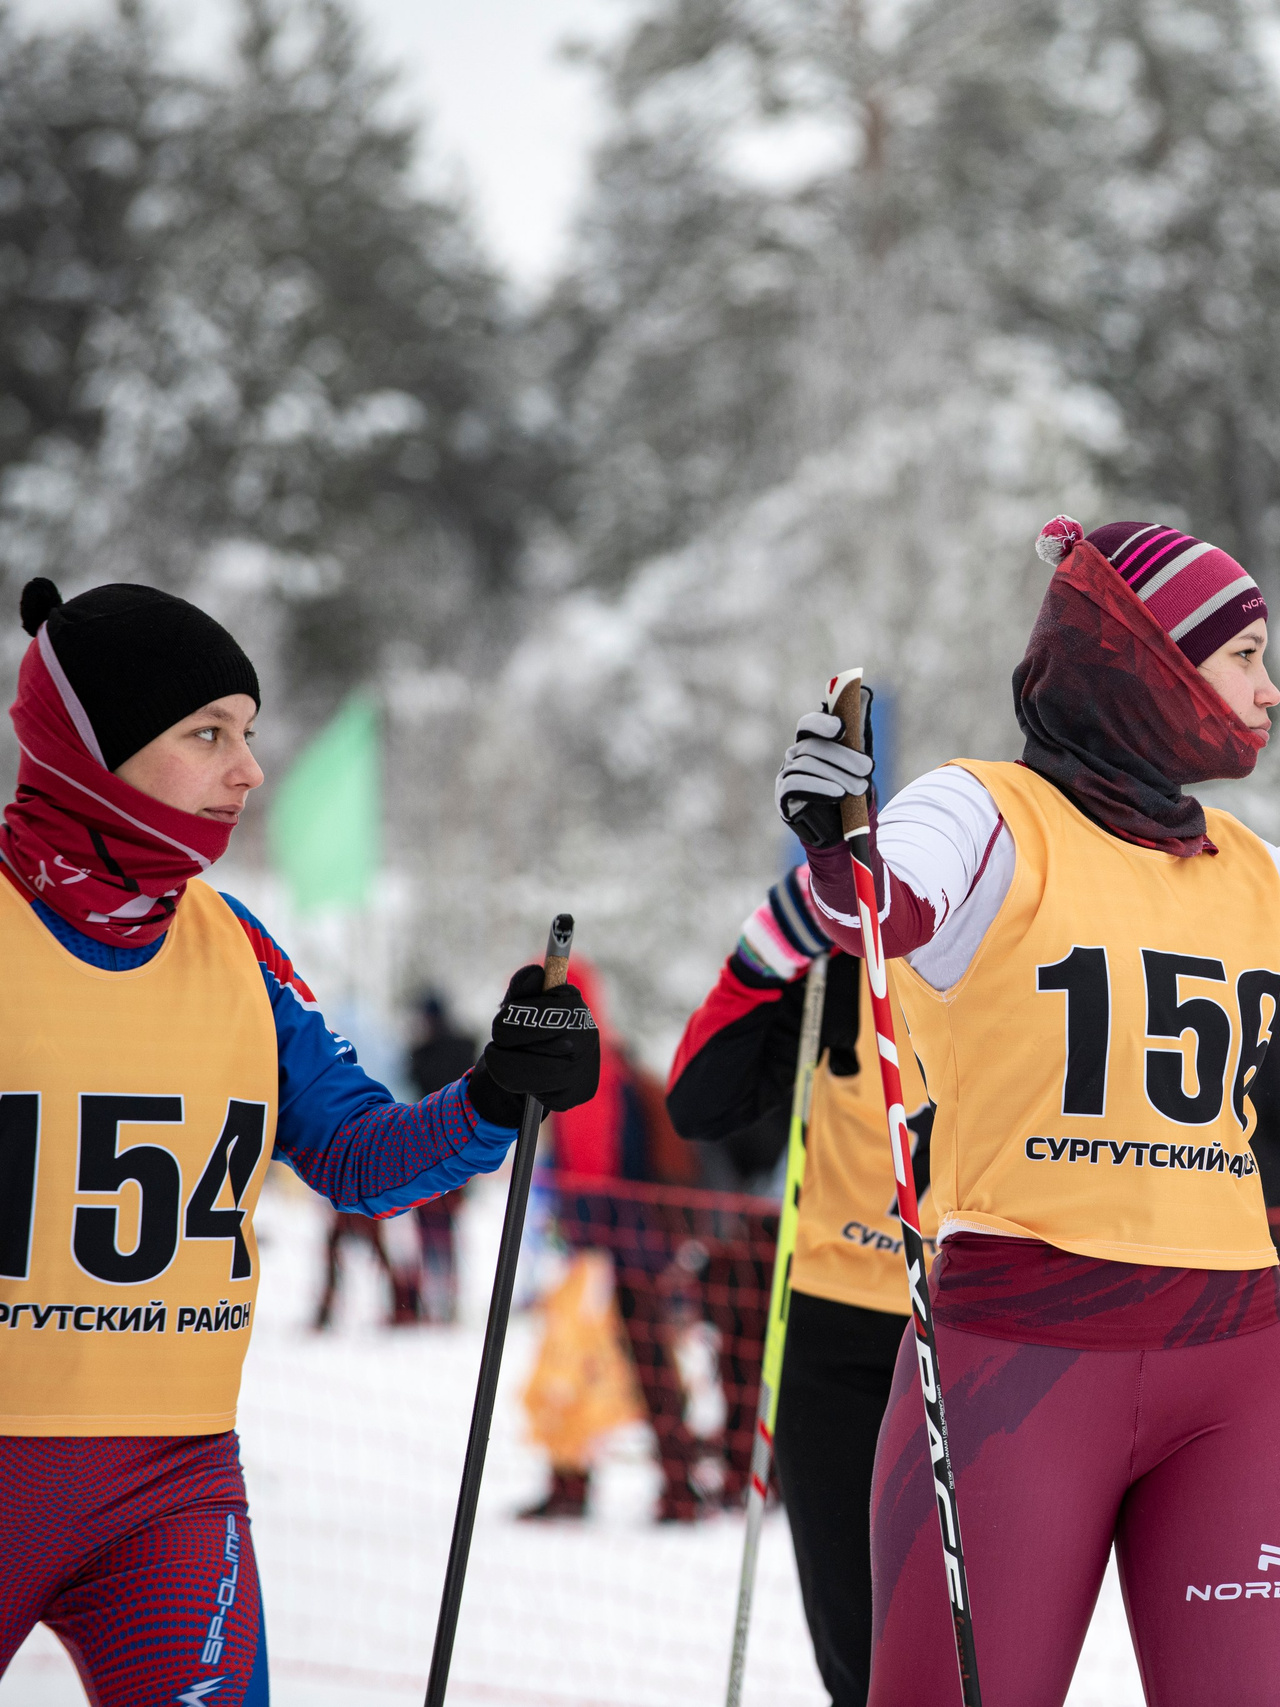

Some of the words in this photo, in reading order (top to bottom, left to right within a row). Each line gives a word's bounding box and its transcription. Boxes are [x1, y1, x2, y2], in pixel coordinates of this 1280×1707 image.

[0, 1091, 268, 1286] 154
[1025, 1136, 1225, 1173] СУРГУТСКИЙ
[176, 1300, 252, 1333] РАЙОН
[200, 1513, 240, 1665] SP-OLIMP
